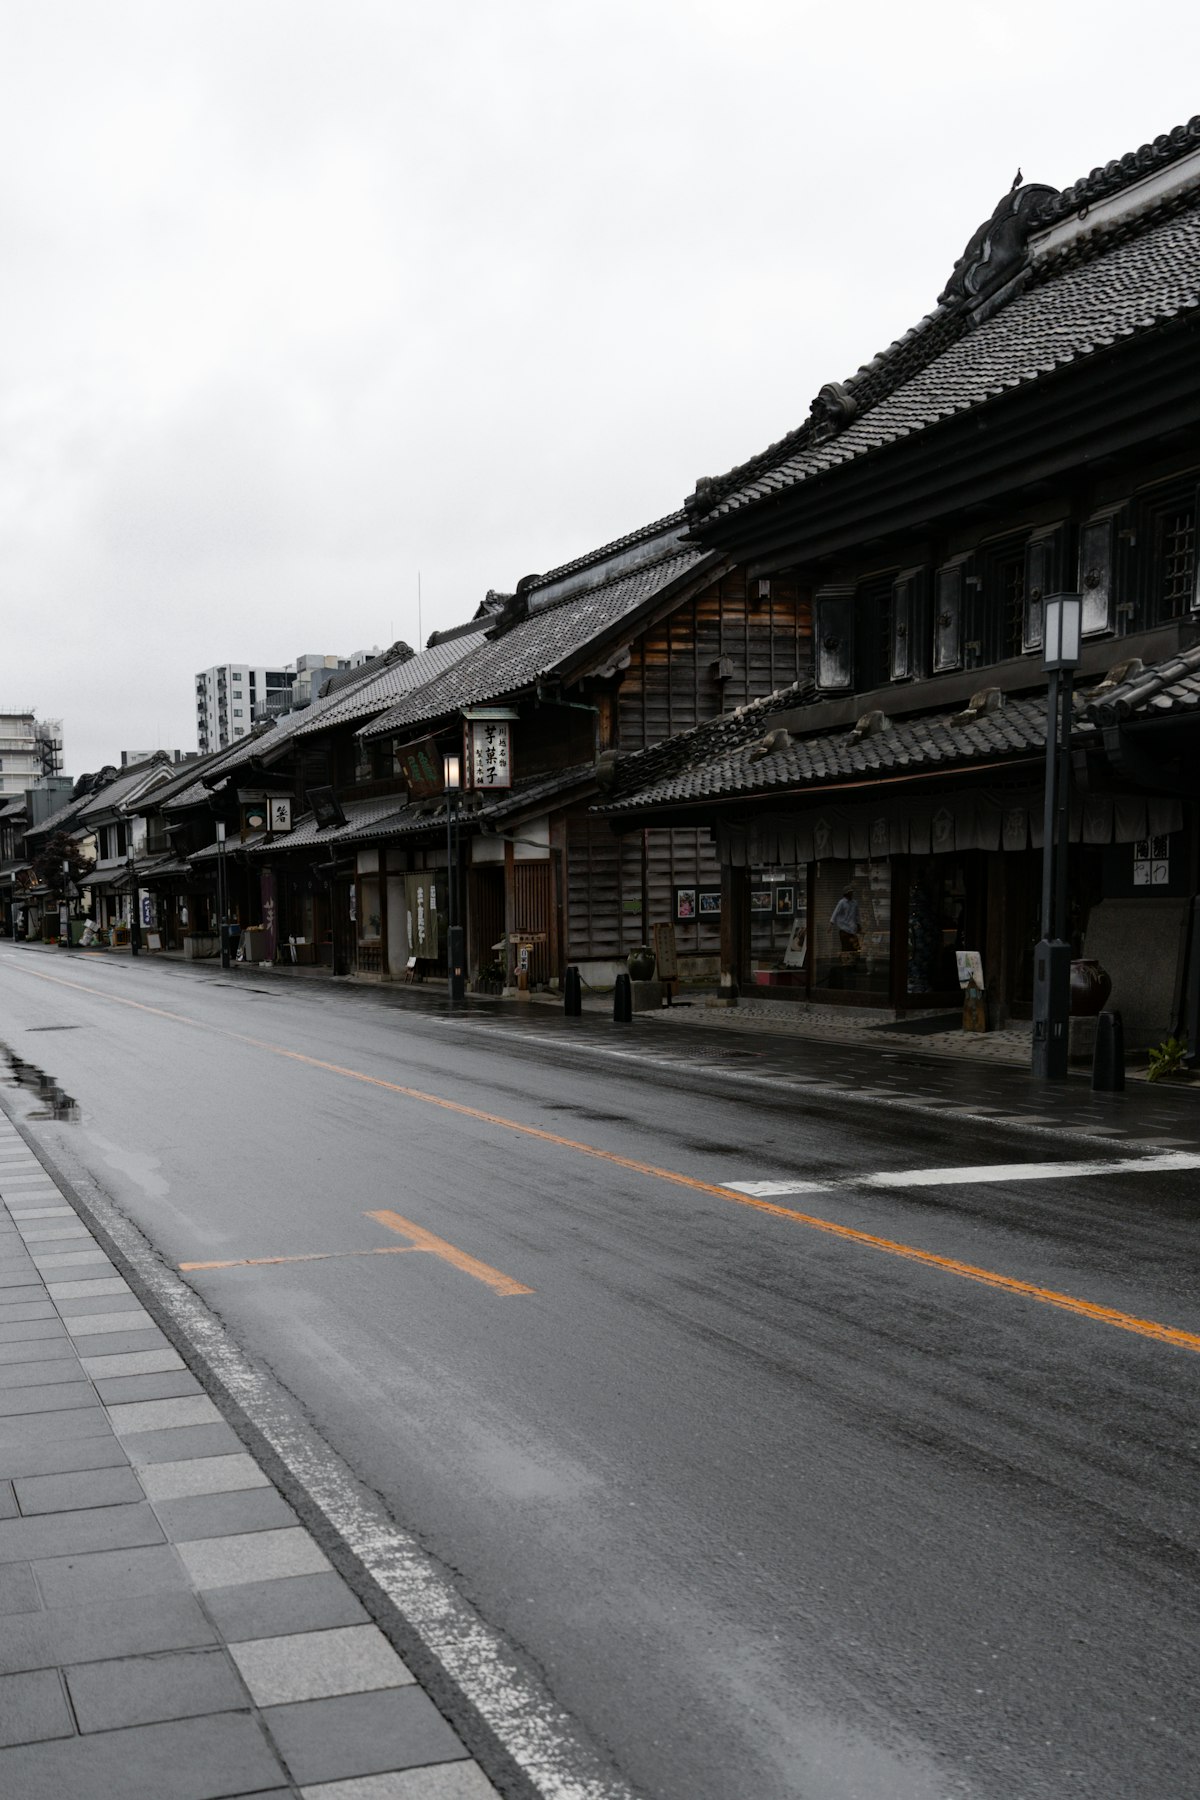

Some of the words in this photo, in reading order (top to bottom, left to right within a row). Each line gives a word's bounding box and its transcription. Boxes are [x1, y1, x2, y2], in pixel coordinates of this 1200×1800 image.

[484, 725, 498, 784] 芋菓子
[274, 805, 288, 823] 箸
